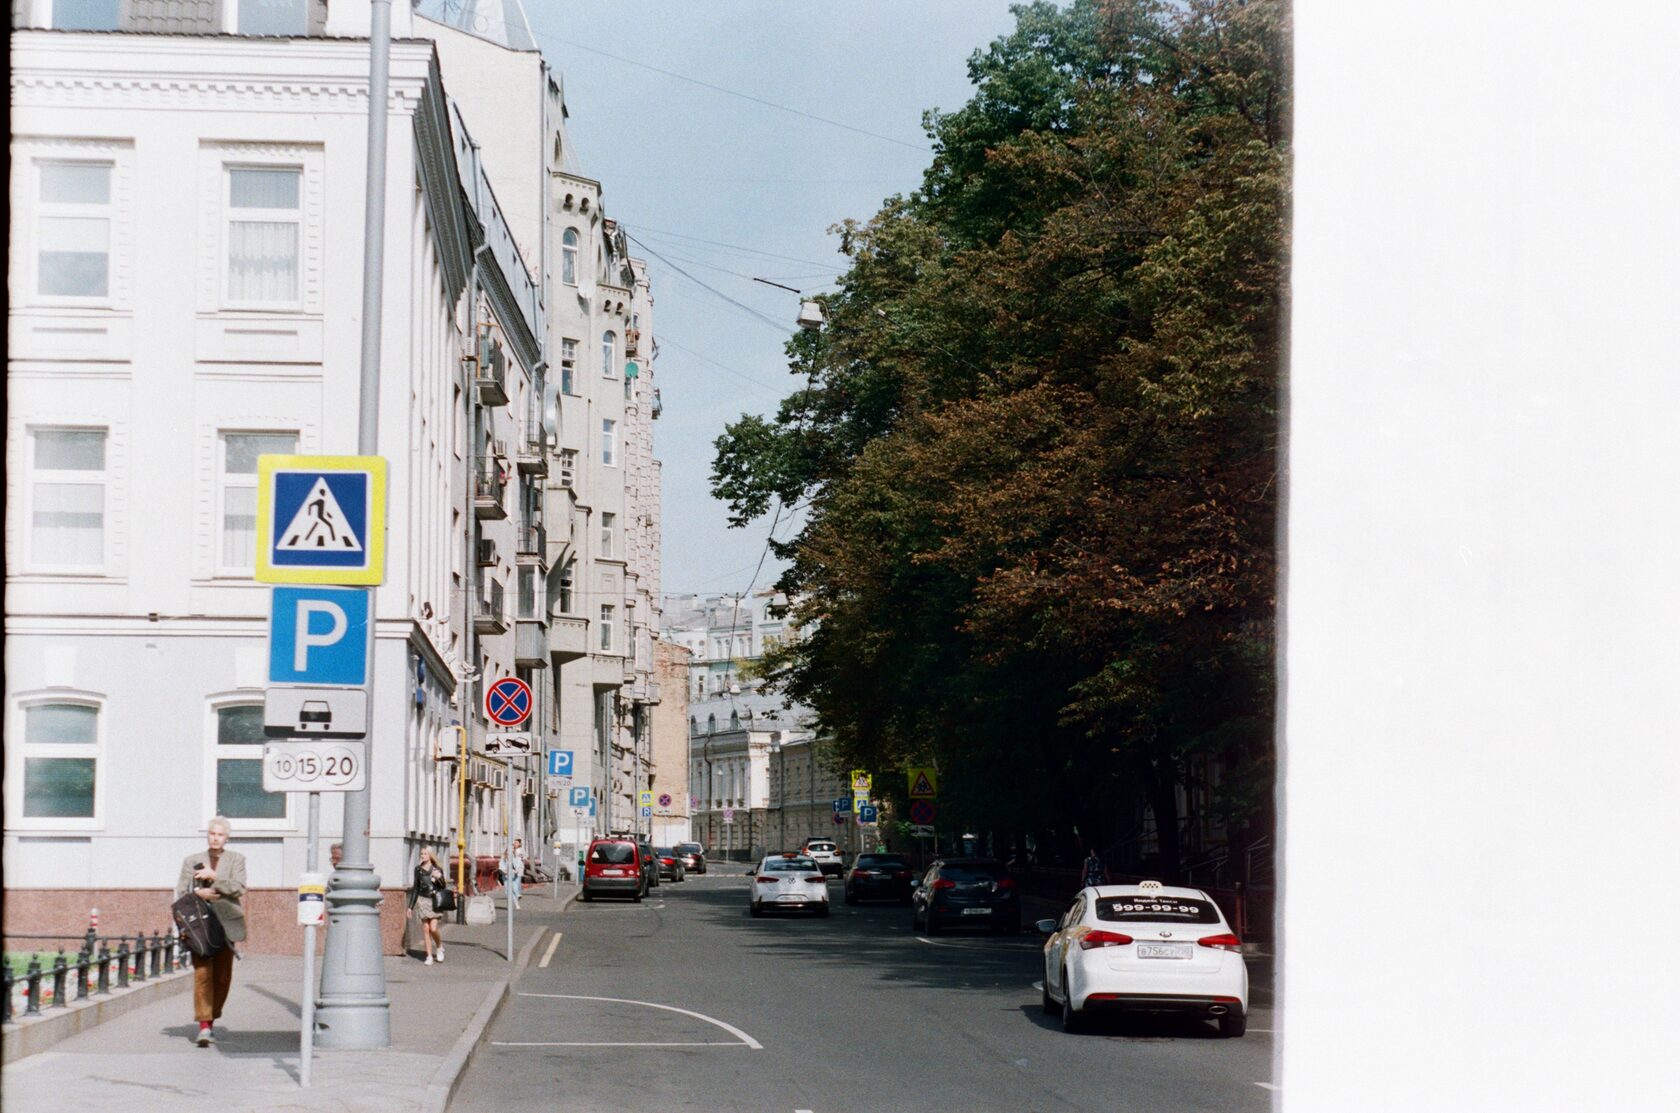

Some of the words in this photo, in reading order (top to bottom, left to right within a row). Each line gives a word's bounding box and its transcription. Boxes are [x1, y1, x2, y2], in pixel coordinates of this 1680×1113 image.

[294, 599, 348, 672] P
[276, 760, 292, 773] 10
[298, 758, 317, 774] 15
[325, 756, 353, 776] 20
[554, 752, 570, 773] P
[573, 788, 586, 804] P
[864, 808, 873, 820] P
